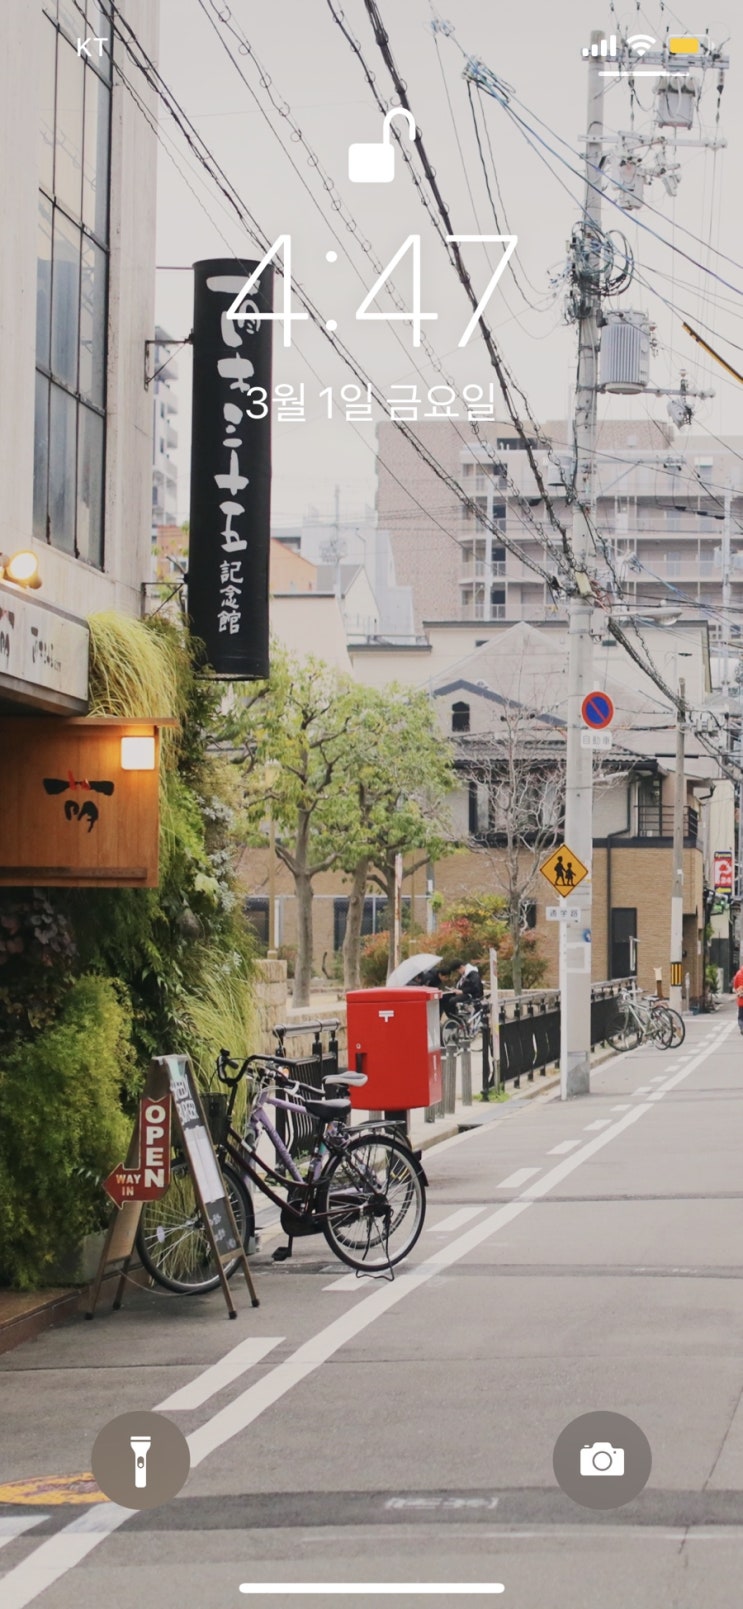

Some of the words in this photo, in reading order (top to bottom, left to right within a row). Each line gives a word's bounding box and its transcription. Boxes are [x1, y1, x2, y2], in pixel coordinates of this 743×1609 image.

[144, 1104, 166, 1188] OPEN
[115, 1174, 142, 1184] WAY
[121, 1186, 135, 1196] IN
